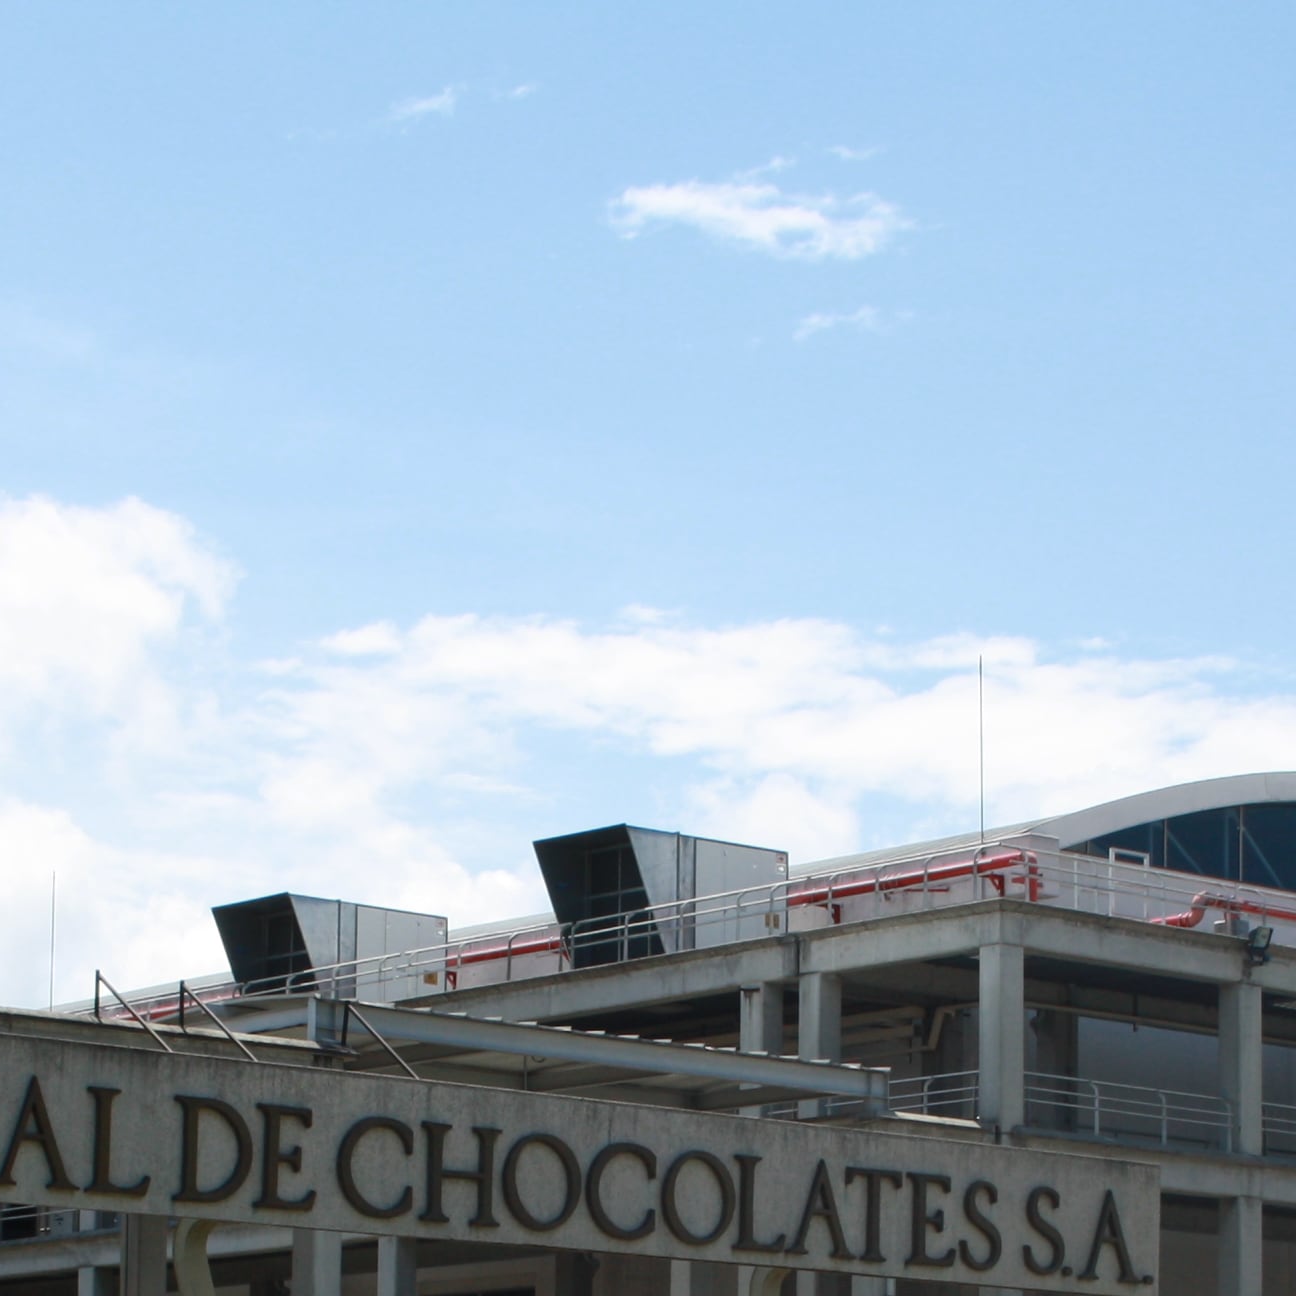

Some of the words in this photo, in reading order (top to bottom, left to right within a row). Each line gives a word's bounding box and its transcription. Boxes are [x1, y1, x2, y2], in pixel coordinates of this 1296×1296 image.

[171, 1094, 317, 1212] DE
[336, 1115, 1004, 1272] CHOCOLATES
[1022, 1185, 1155, 1285] S.A.
